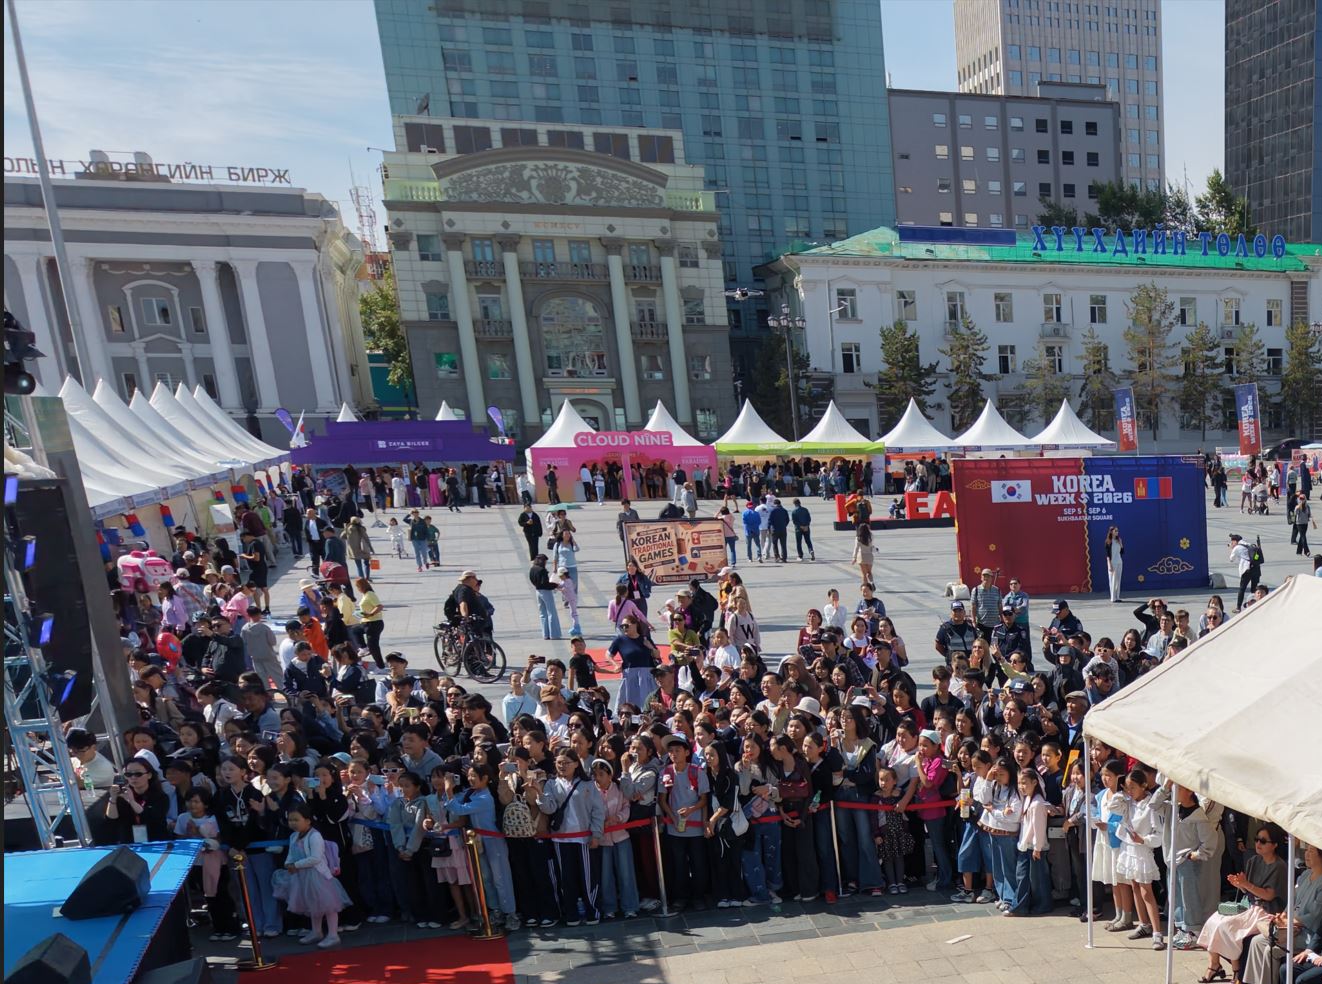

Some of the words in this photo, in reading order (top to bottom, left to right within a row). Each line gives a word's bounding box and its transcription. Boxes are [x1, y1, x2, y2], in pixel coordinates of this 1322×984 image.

[227, 166, 291, 184] БИРЖ
[1031, 223, 1186, 257] ХҮҮХДИЙН
[1200, 231, 1286, 259] ТӨЛӨӨ
[577, 435, 630, 446] CLOUD
[1052, 475, 1115, 493] KOREA
[1036, 494, 1076, 505] WEEK
[1094, 492, 1132, 504] 2026
[632, 532, 671, 547] KOREAN
[633, 541, 674, 556] TRADITIONAL
[638, 548, 673, 563] GAMES
